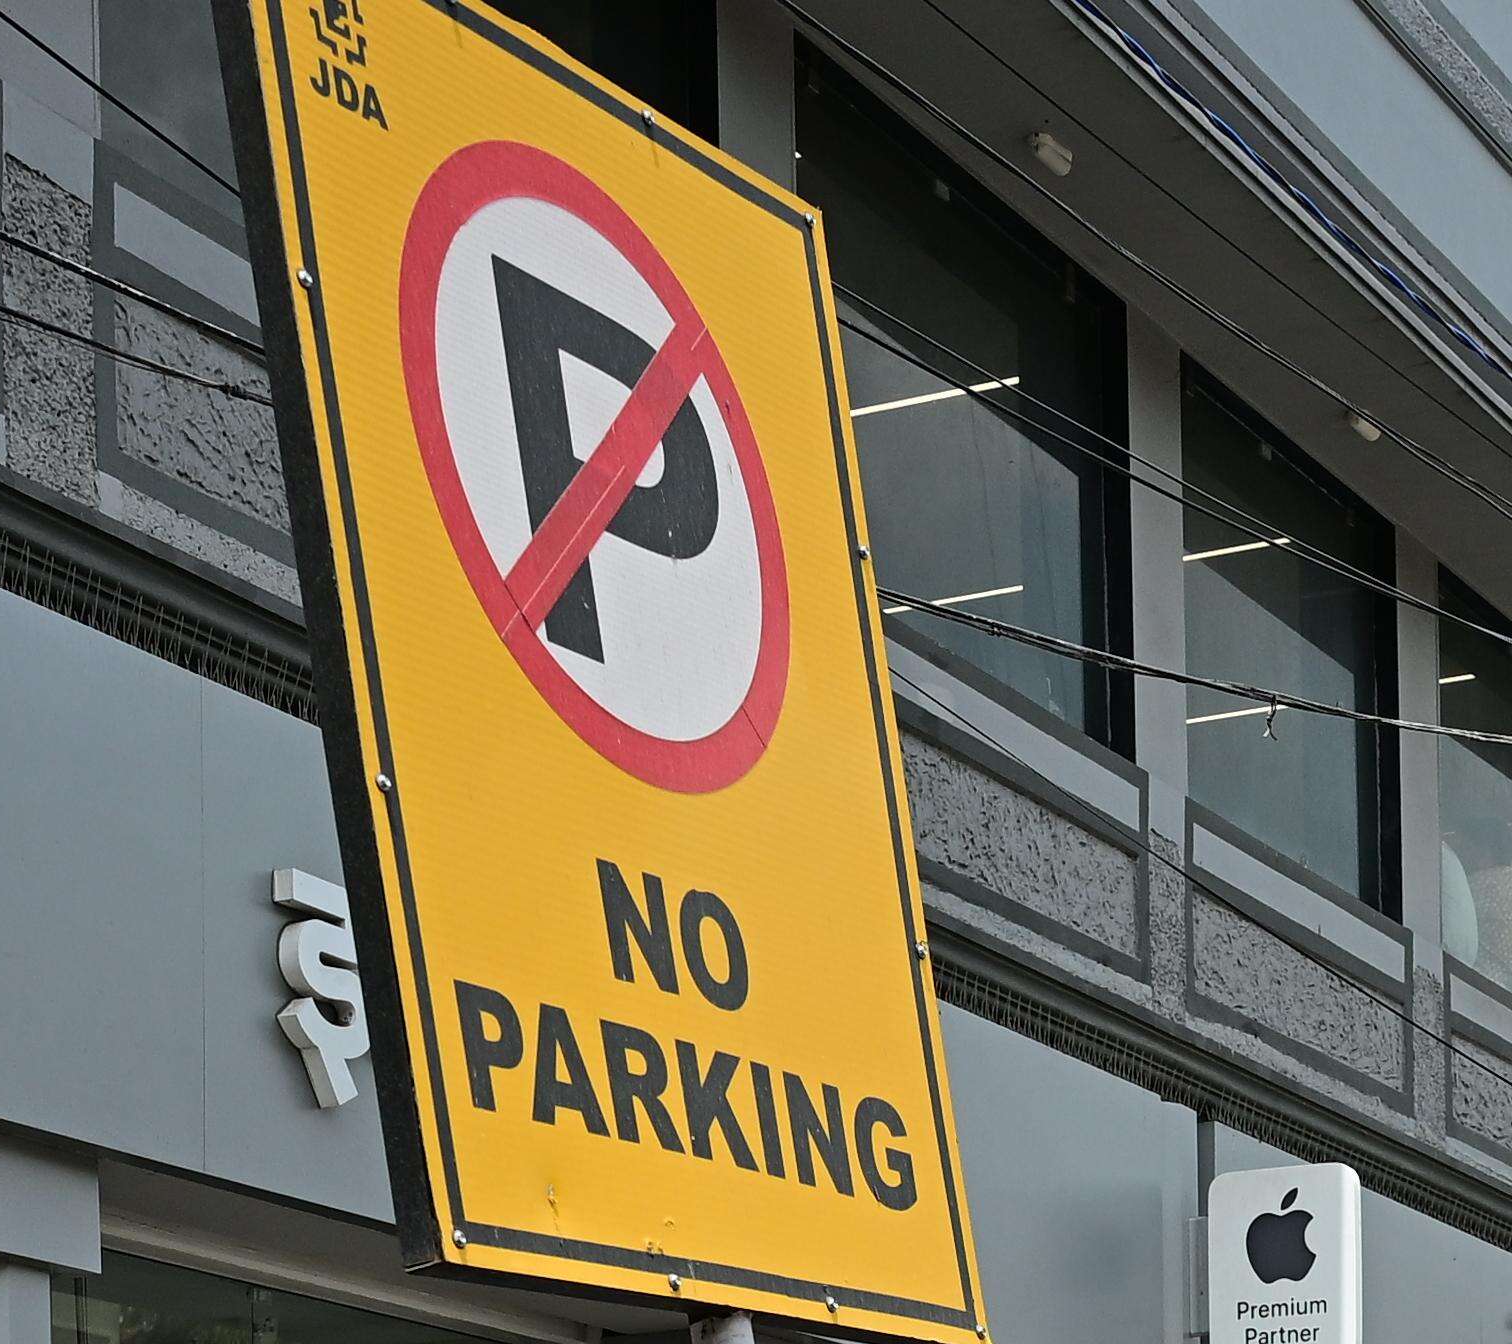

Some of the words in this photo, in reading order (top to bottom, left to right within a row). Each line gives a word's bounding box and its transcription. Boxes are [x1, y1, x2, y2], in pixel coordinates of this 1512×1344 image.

[310, 58, 389, 132] JDA
[596, 858, 750, 1011] NO
[453, 979, 916, 1211] PARKING
[1236, 1295, 1328, 1322] Premium
